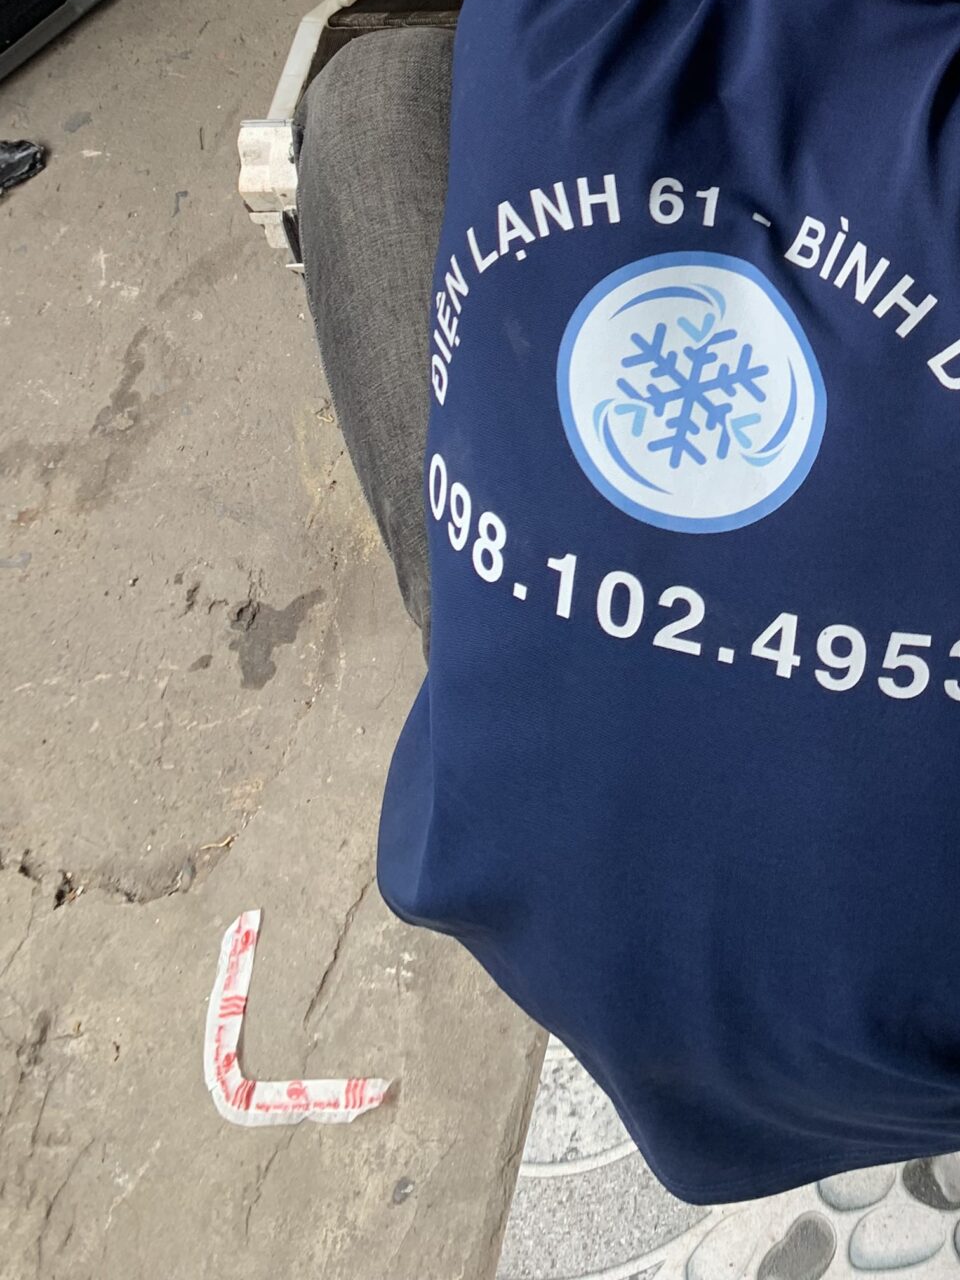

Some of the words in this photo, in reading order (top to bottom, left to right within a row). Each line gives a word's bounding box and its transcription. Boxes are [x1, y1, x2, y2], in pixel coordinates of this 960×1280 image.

[431, 254, 469, 406] ĐIỆN
[466, 173, 621, 274] LẠNH
[649, 177, 720, 227] 61
[784, 215, 938, 338] BÌNH
